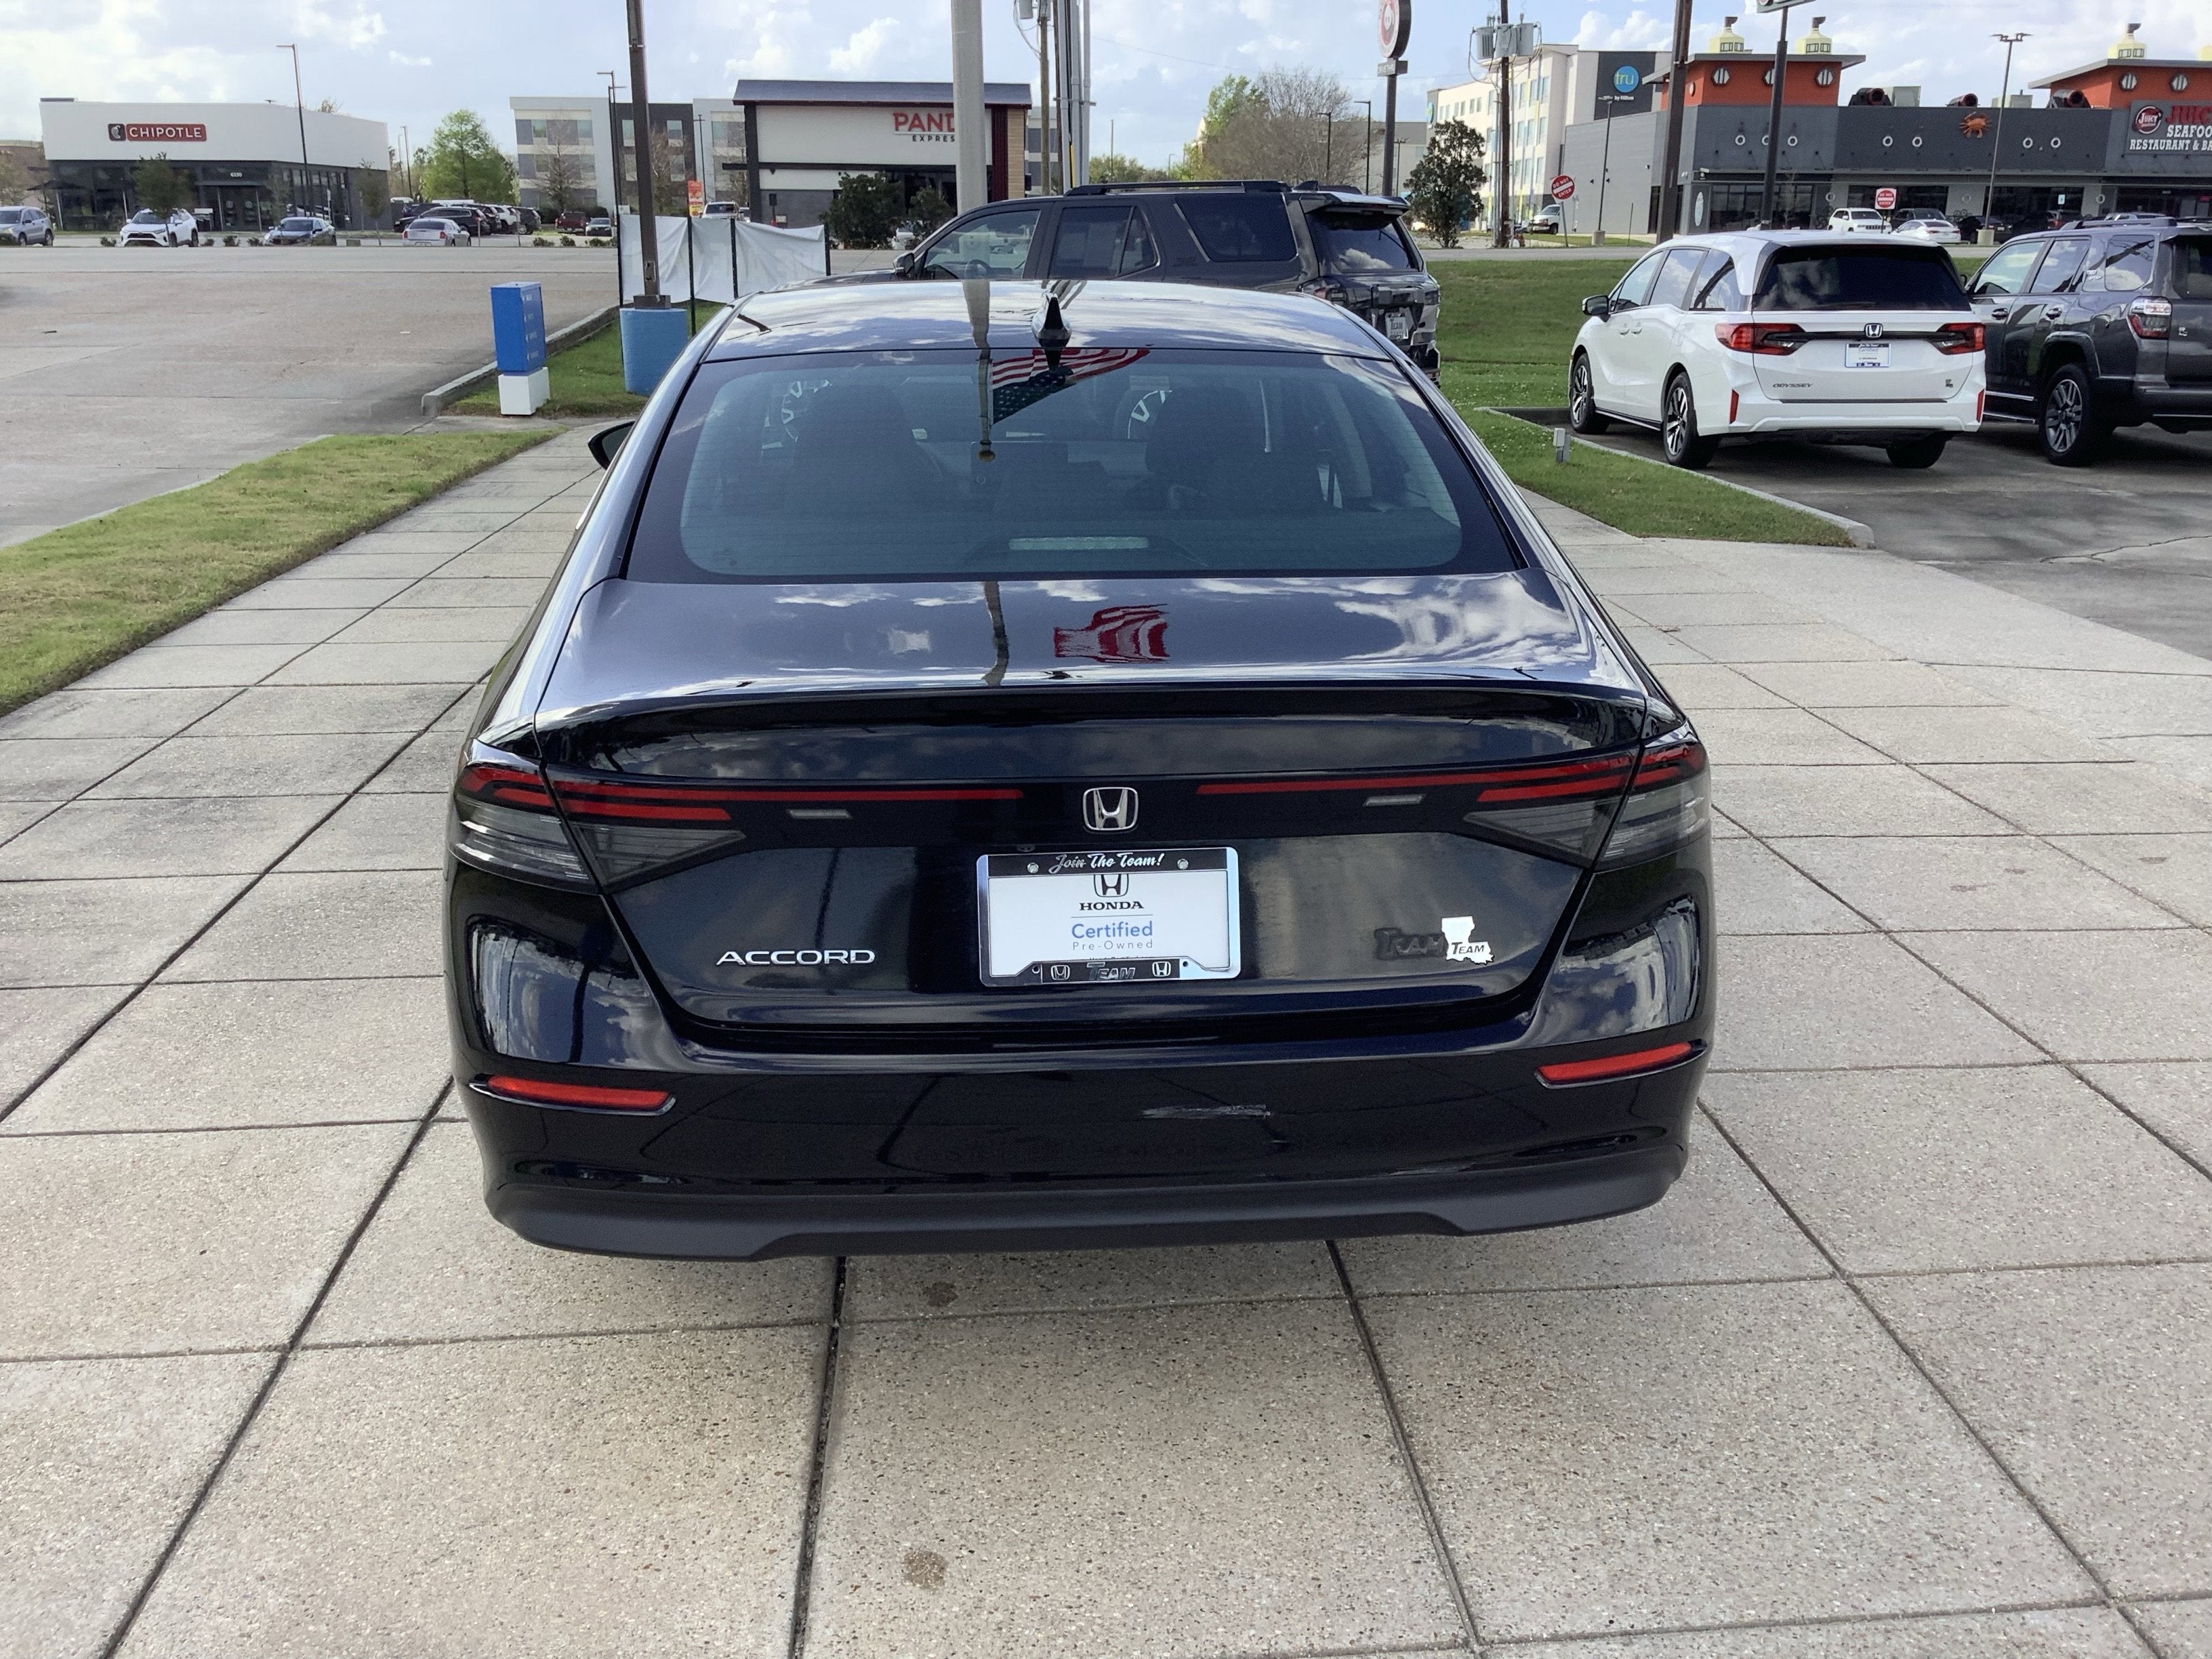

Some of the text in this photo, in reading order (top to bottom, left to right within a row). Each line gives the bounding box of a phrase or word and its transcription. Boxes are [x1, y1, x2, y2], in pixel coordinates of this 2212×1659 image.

[1614, 71, 1635, 85] tru
[2165, 105, 2212, 124] JUIC
[893, 112, 955, 132] PAND
[129, 127, 203, 138] CHIPOTLE
[2166, 124, 2212, 138] SEAFOO
[2129, 138, 2212, 151] RESTAURANT & BA
[1558, 187, 1572, 198] ENTER
[1048, 851, 1166, 875] Join The Team!
[1079, 901, 1145, 912] HONDA
[1071, 920, 1153, 939] Certified
[1072, 939, 1153, 951] Pre-Owned
[1451, 941, 1486, 956] TEAM
[716, 949, 876, 966] ACCORD
[1086, 962, 1136, 981] TEAM
